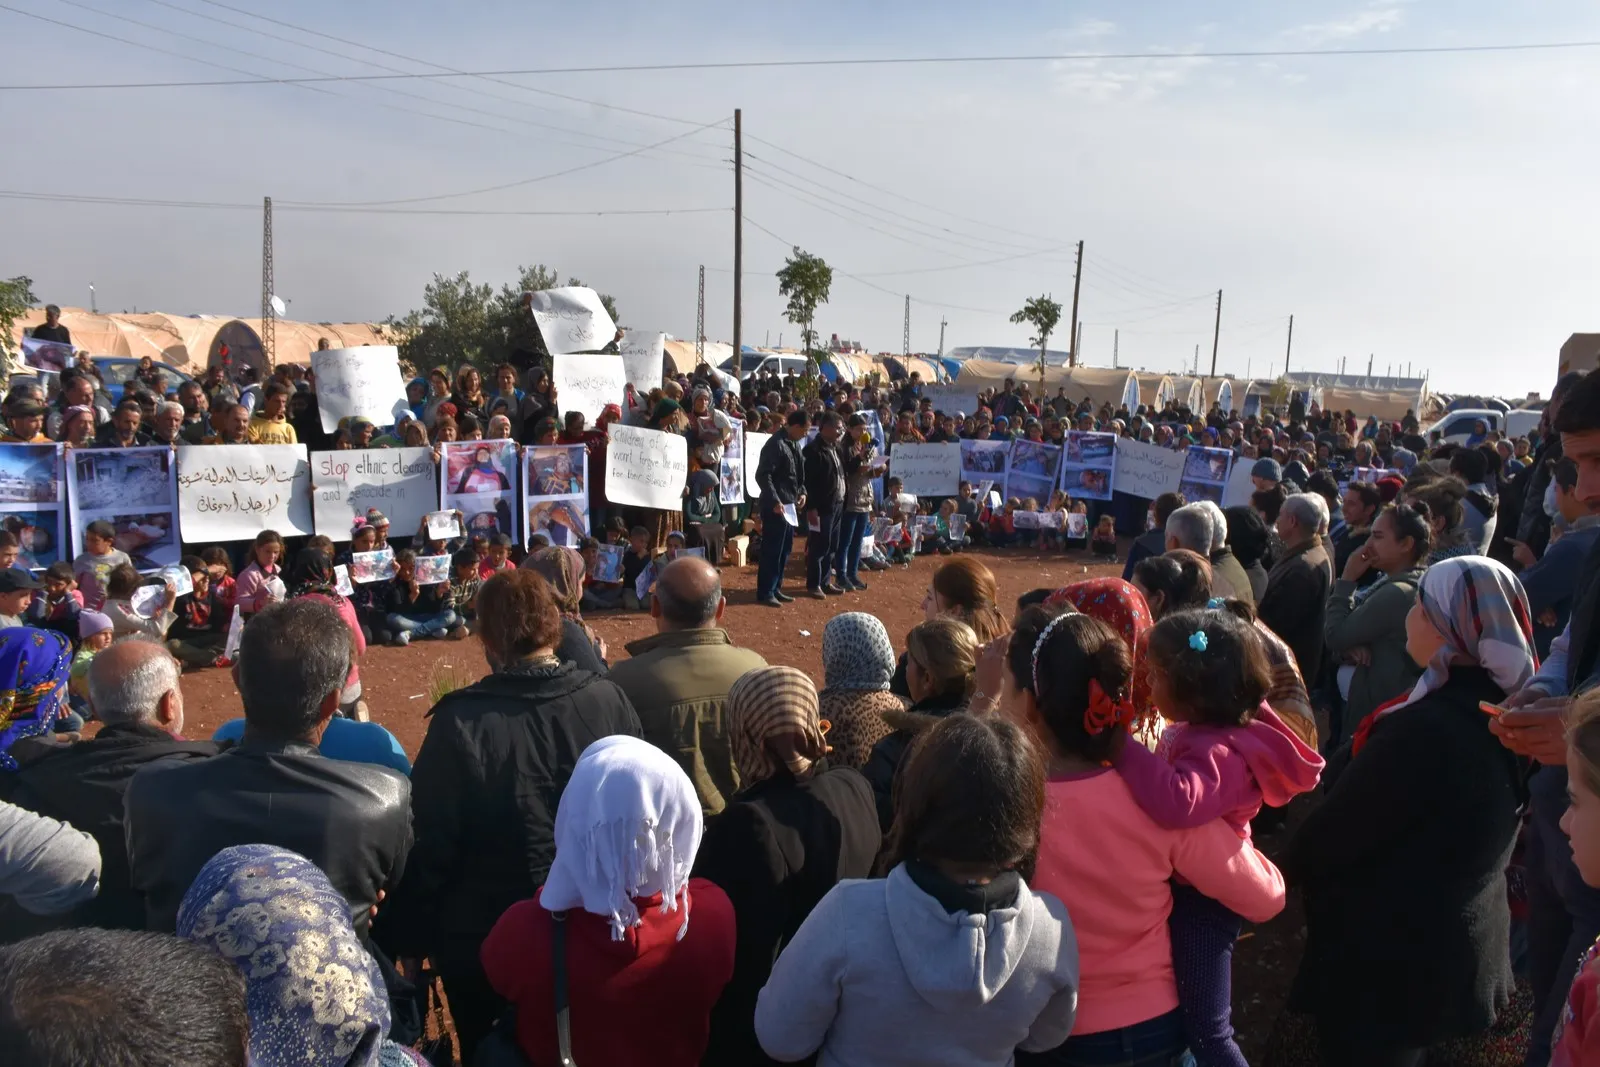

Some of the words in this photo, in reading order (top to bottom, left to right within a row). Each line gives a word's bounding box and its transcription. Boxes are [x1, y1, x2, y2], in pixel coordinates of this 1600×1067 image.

[649, 434, 660, 449] of
[355, 452, 388, 475] ethnic
[392, 452, 432, 481] cleansing
[639, 451, 659, 471] forgive
[204, 465, 238, 486] الدولية
[197, 490, 239, 513] أردوغان
[322, 481, 341, 502] and
[347, 478, 392, 506] genocide
[396, 486, 405, 499] in
